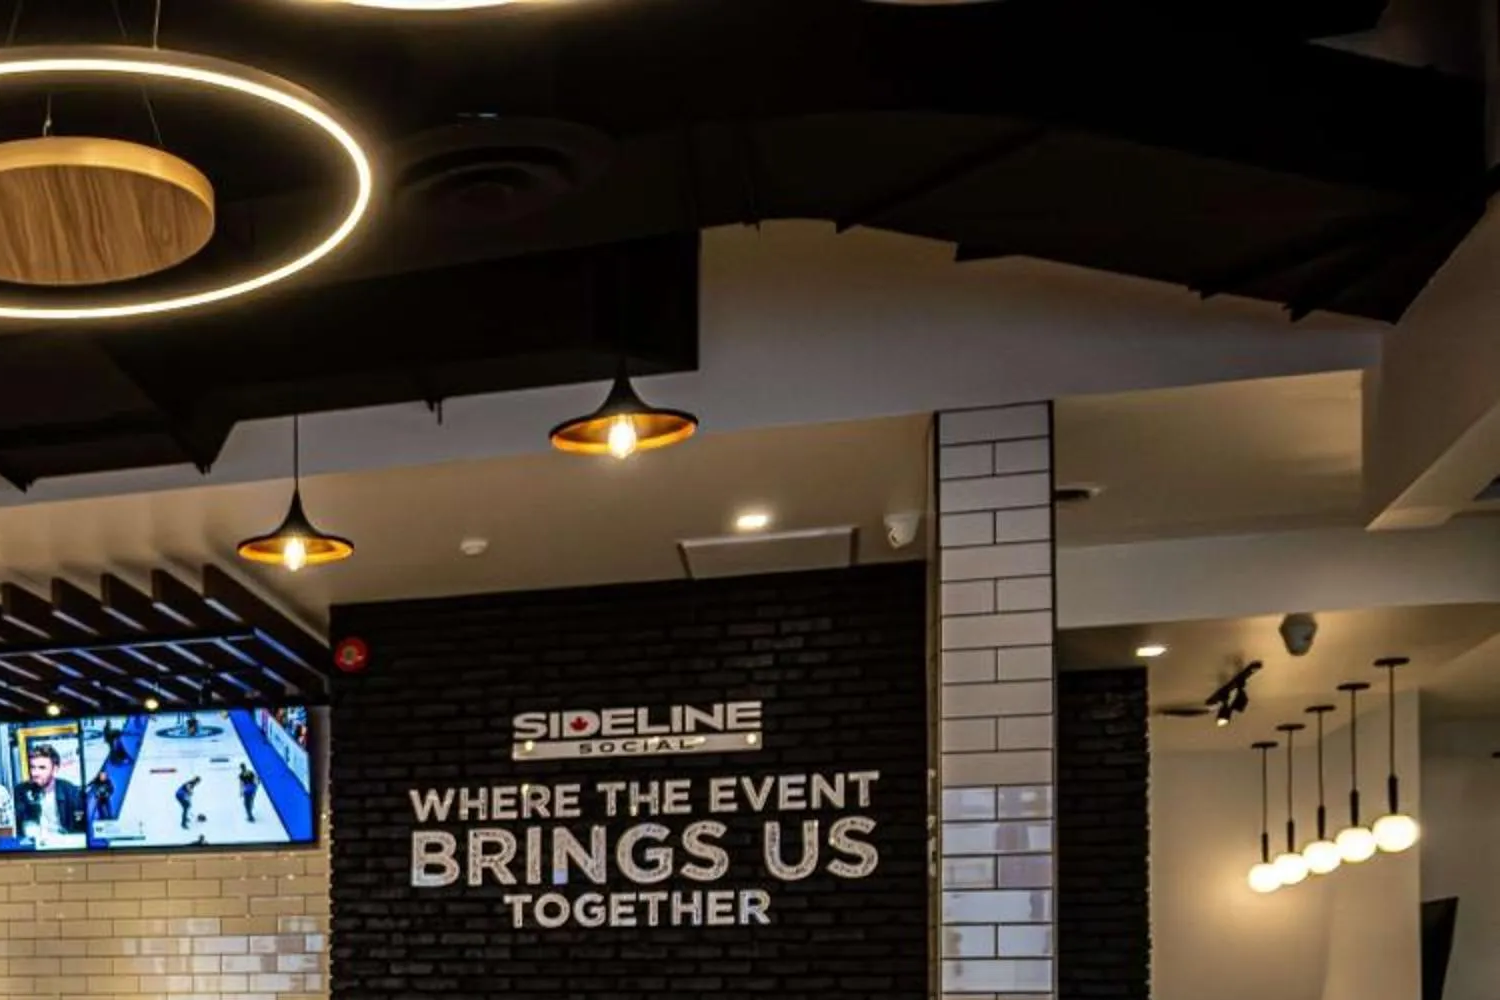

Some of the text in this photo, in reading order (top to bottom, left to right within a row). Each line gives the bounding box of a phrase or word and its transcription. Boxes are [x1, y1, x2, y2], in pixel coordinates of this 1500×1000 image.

[513, 701, 762, 739] SIDELINE
[579, 739, 695, 755] SOCIAL
[409, 771, 879, 822] WHERE THE EVENT
[411, 816, 878, 887] BRINGS US
[504, 889, 771, 928] TOGETHER
